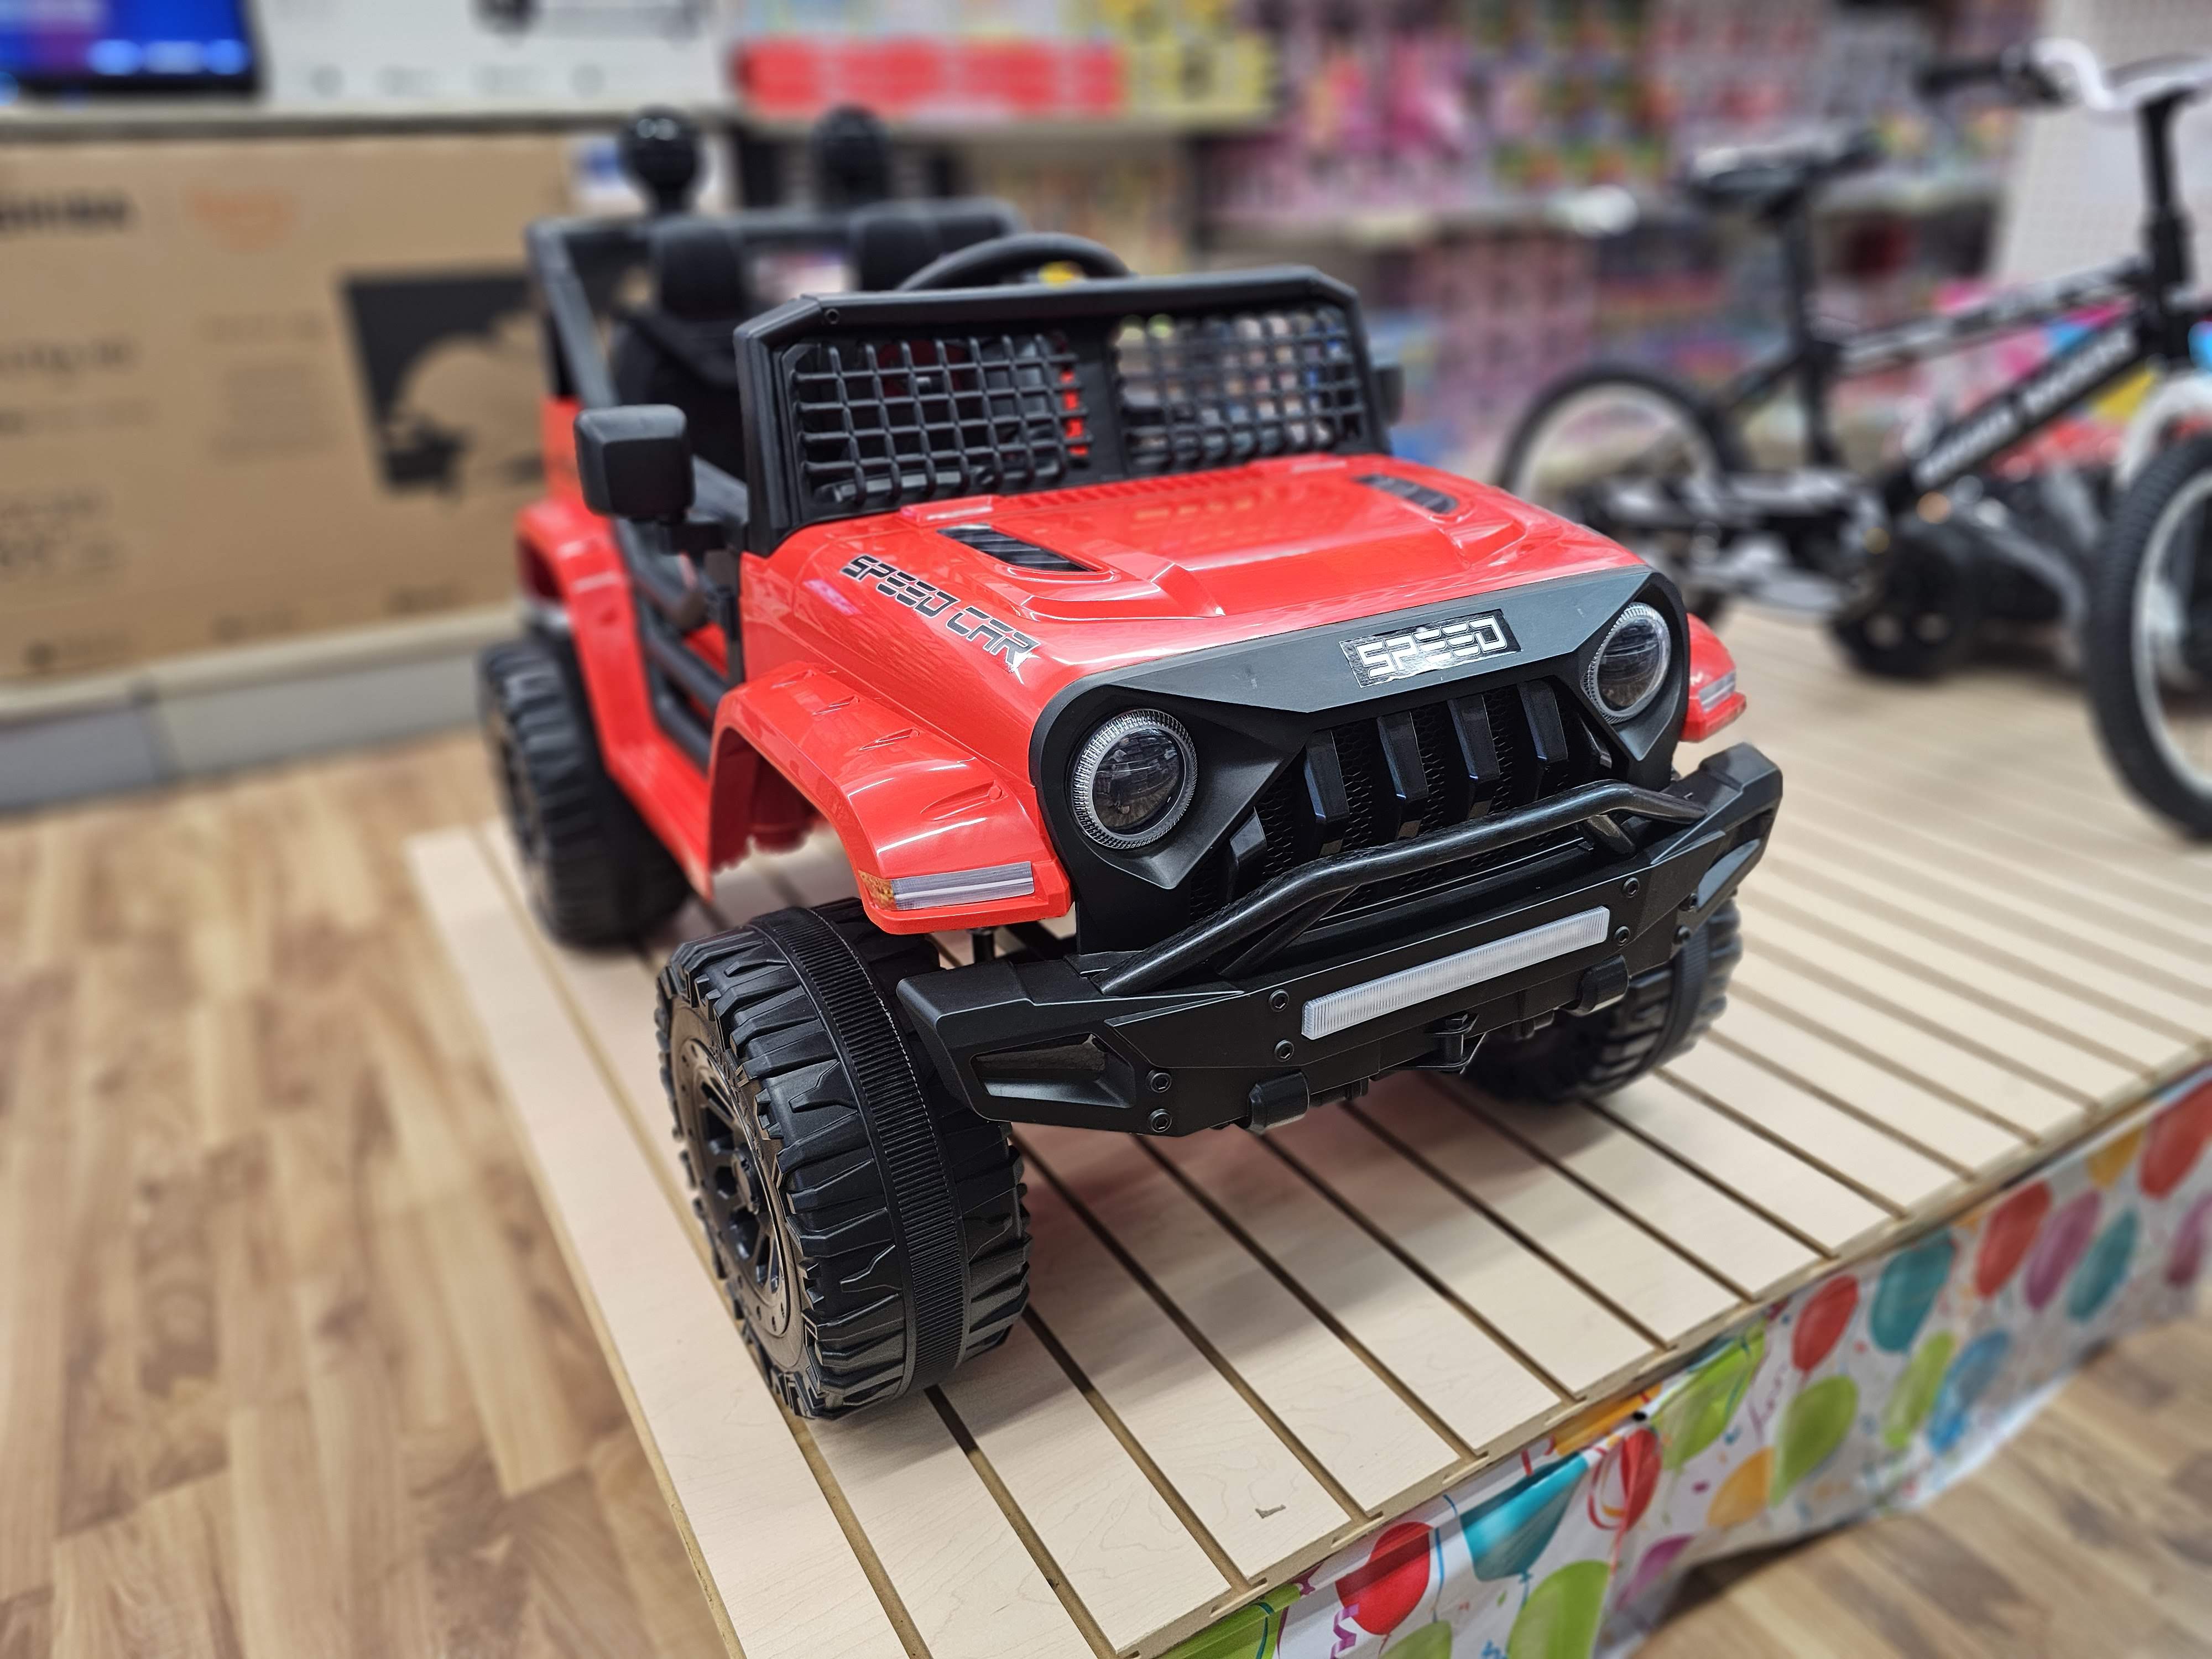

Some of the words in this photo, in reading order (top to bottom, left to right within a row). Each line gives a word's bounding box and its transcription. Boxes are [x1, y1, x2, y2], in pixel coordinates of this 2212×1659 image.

[840, 555, 959, 618] SPEED
[946, 606, 1041, 667] CAR
[1355, 615, 1507, 680] SPEED
